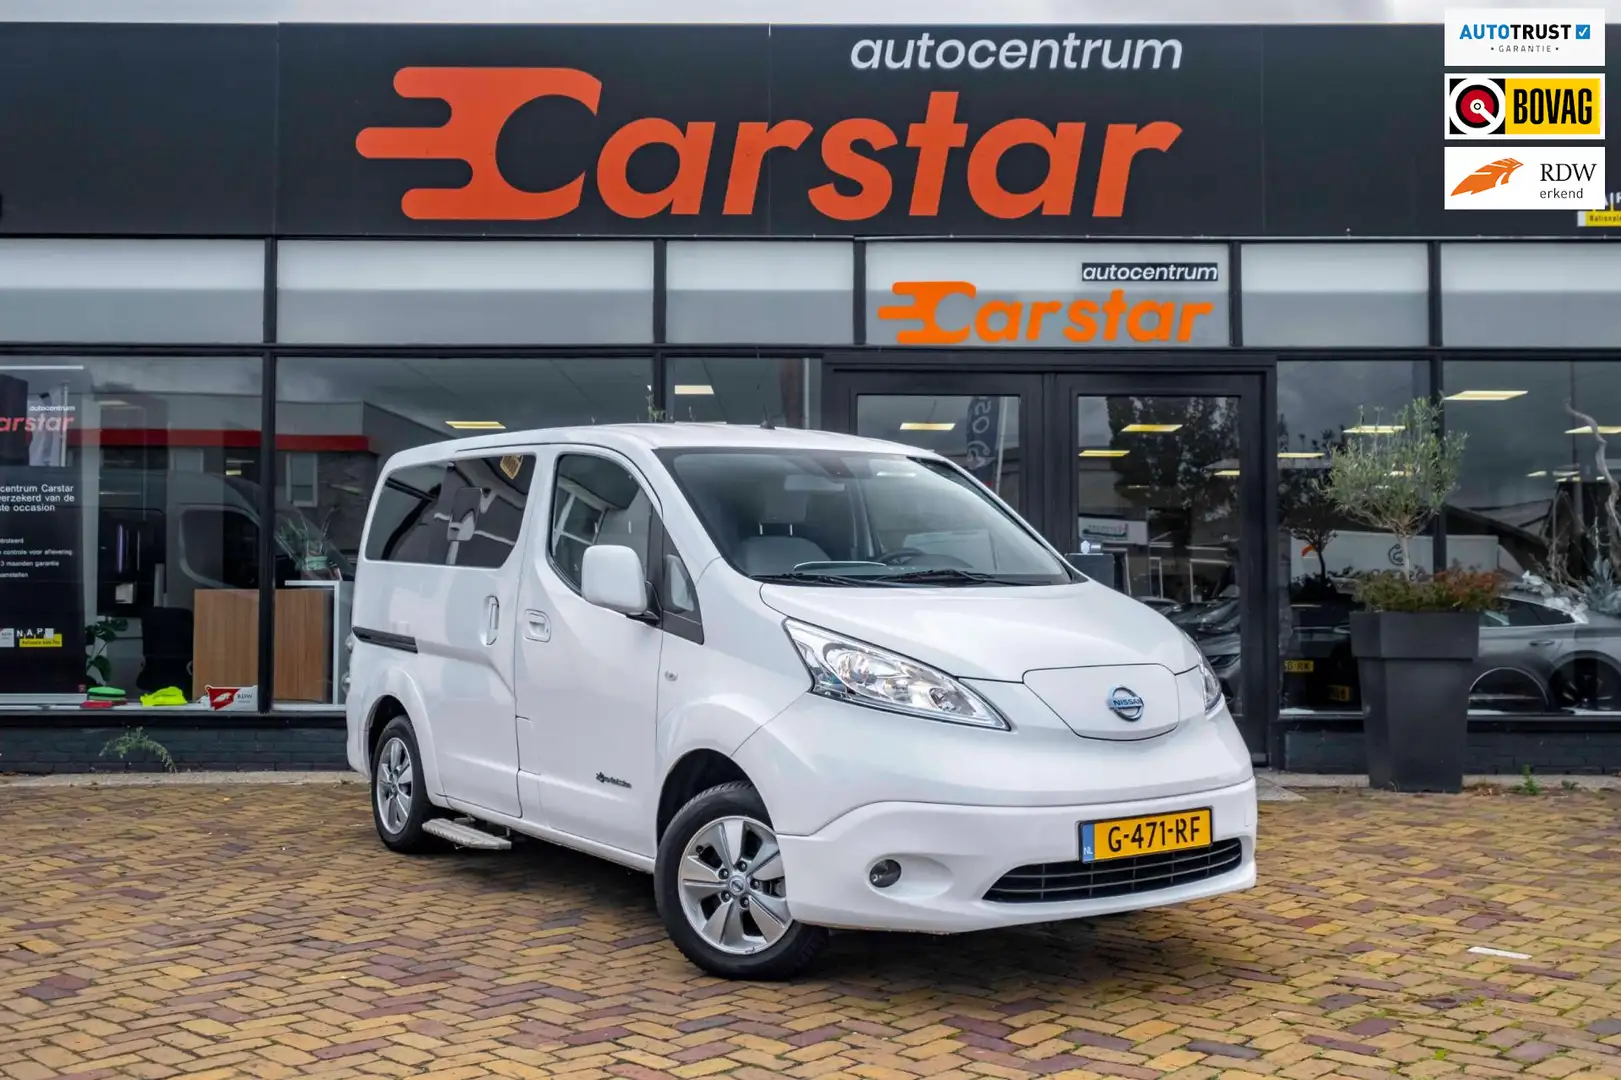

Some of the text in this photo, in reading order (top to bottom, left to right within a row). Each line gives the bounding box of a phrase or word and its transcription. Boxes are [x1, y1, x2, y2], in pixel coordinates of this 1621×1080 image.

[850, 32, 1183, 69] autocentrum
[355, 66, 1183, 221] Carstar
[1082, 263, 1218, 281] autocentrum
[877, 280, 1215, 343] Carstar
[41, 483, 74, 493] Carstar
[63, 493, 75, 502] de
[13, 503, 55, 511] occasion
[1113, 698, 1143, 707] NISSAN
[1108, 815, 1201, 853] G-471-RF
[1083, 846, 1093, 855] NL
